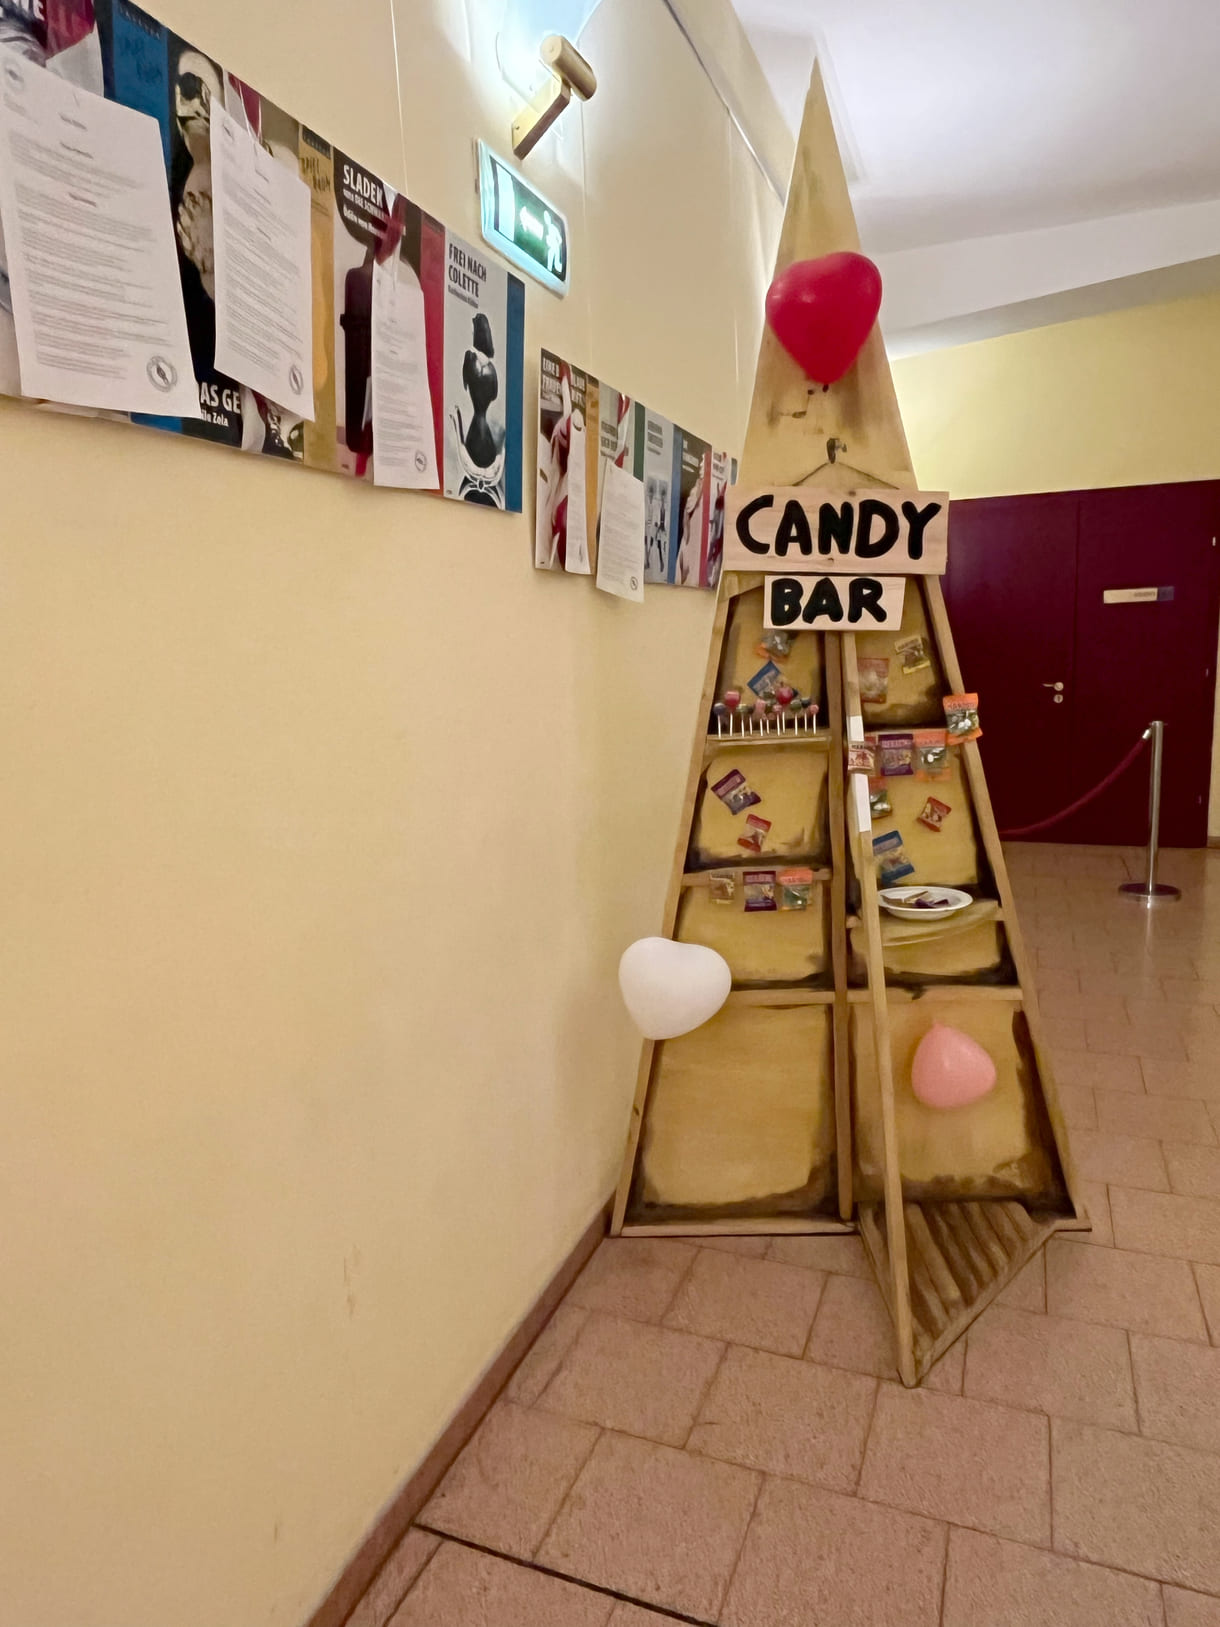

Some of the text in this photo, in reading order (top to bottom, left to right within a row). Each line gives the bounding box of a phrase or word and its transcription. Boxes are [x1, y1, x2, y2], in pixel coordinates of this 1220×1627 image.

[342, 164, 384, 209] SLADEK
[448, 264, 479, 298] COLETTE
[449, 243, 487, 283] FREI NACH
[200, 381, 241, 414] AS GE
[212, 412, 229, 427] Zola
[736, 494, 942, 560] CANDY
[771, 577, 888, 626] BAR
